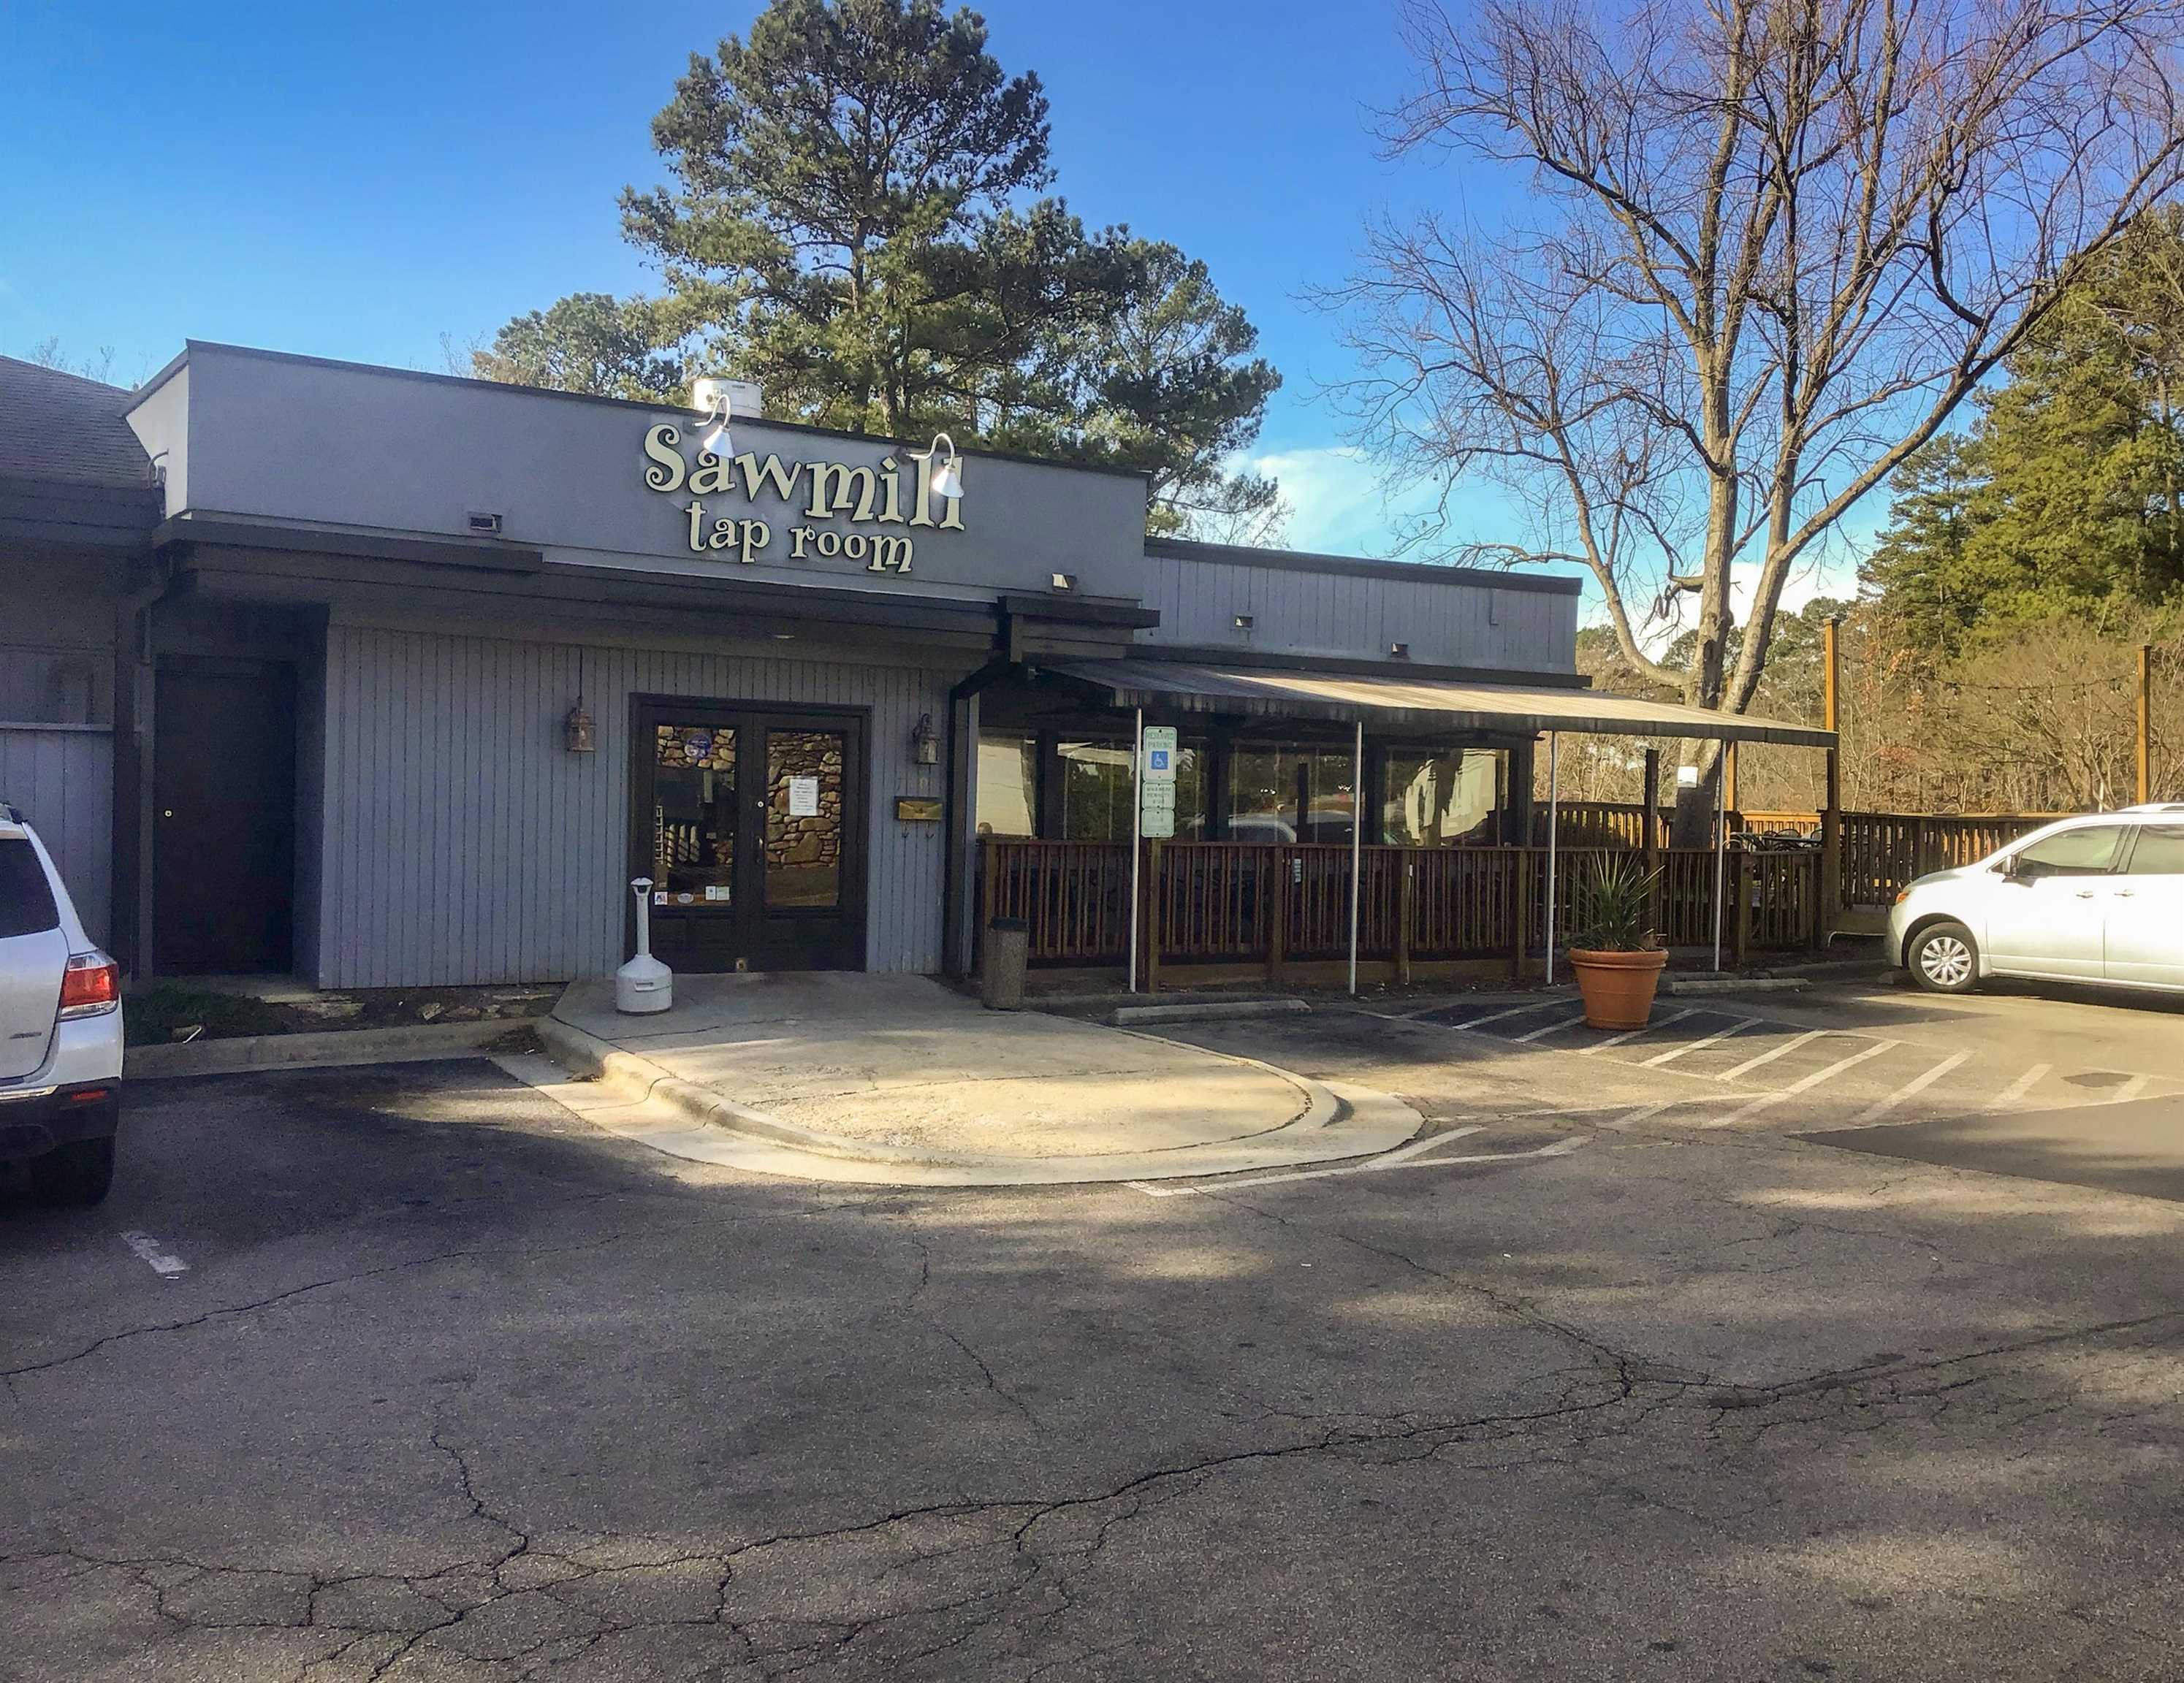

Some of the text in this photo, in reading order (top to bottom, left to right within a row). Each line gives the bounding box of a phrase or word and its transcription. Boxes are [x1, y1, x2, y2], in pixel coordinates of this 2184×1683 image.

[643, 423, 966, 531] Sawmill
[685, 500, 914, 573] tap room
